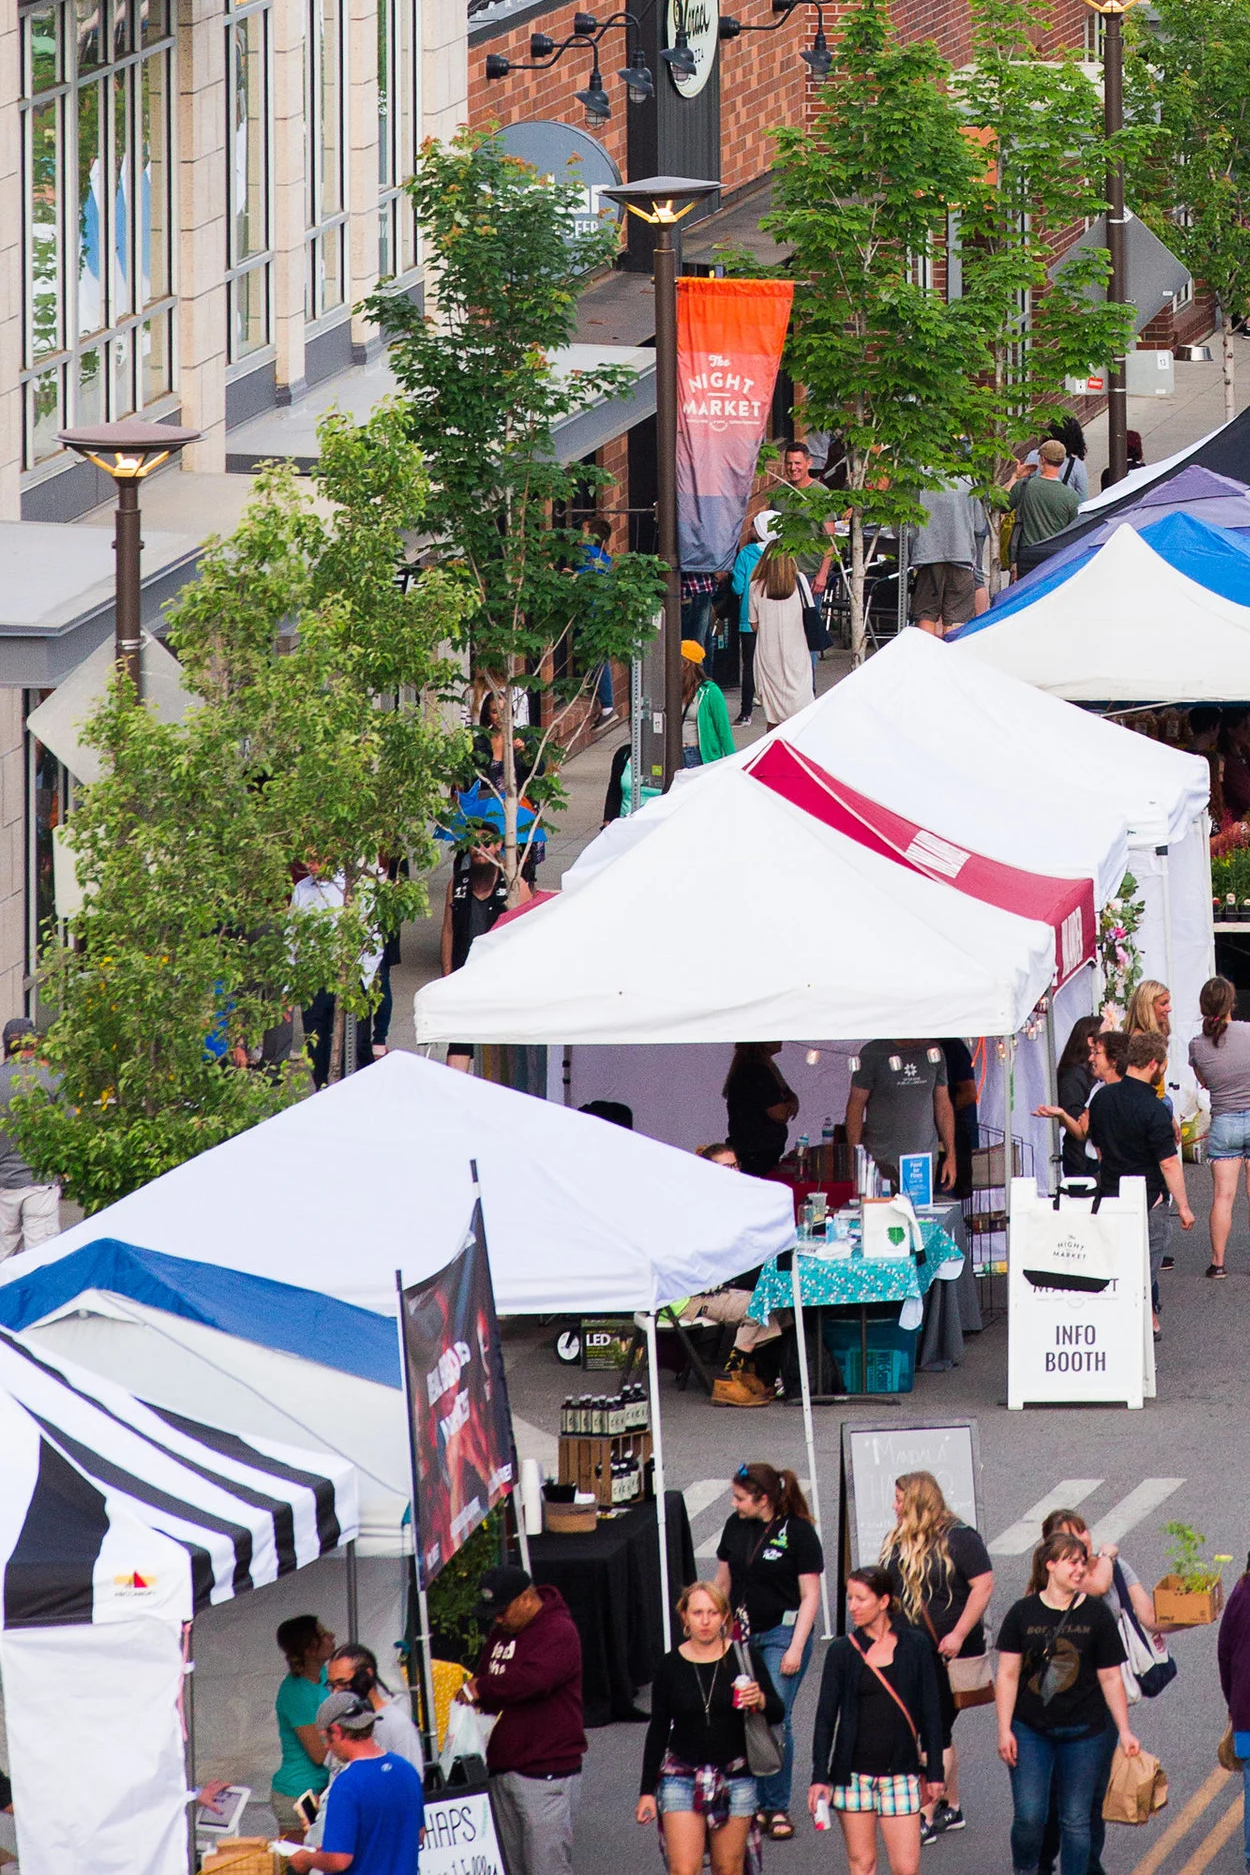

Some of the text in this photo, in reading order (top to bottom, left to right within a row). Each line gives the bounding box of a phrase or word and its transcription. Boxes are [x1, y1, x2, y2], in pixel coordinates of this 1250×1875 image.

[708, 354, 731, 367] The
[688, 372, 754, 395] NIGHT
[683, 399, 761, 417] MARKET
[1053, 1251, 1087, 1260] MARKET
[586, 1333, 611, 1347] LED
[1055, 1324, 1096, 1346] INFO
[1045, 1350, 1106, 1373] BOOTH
[419, 1806, 476, 1852] HAPS
